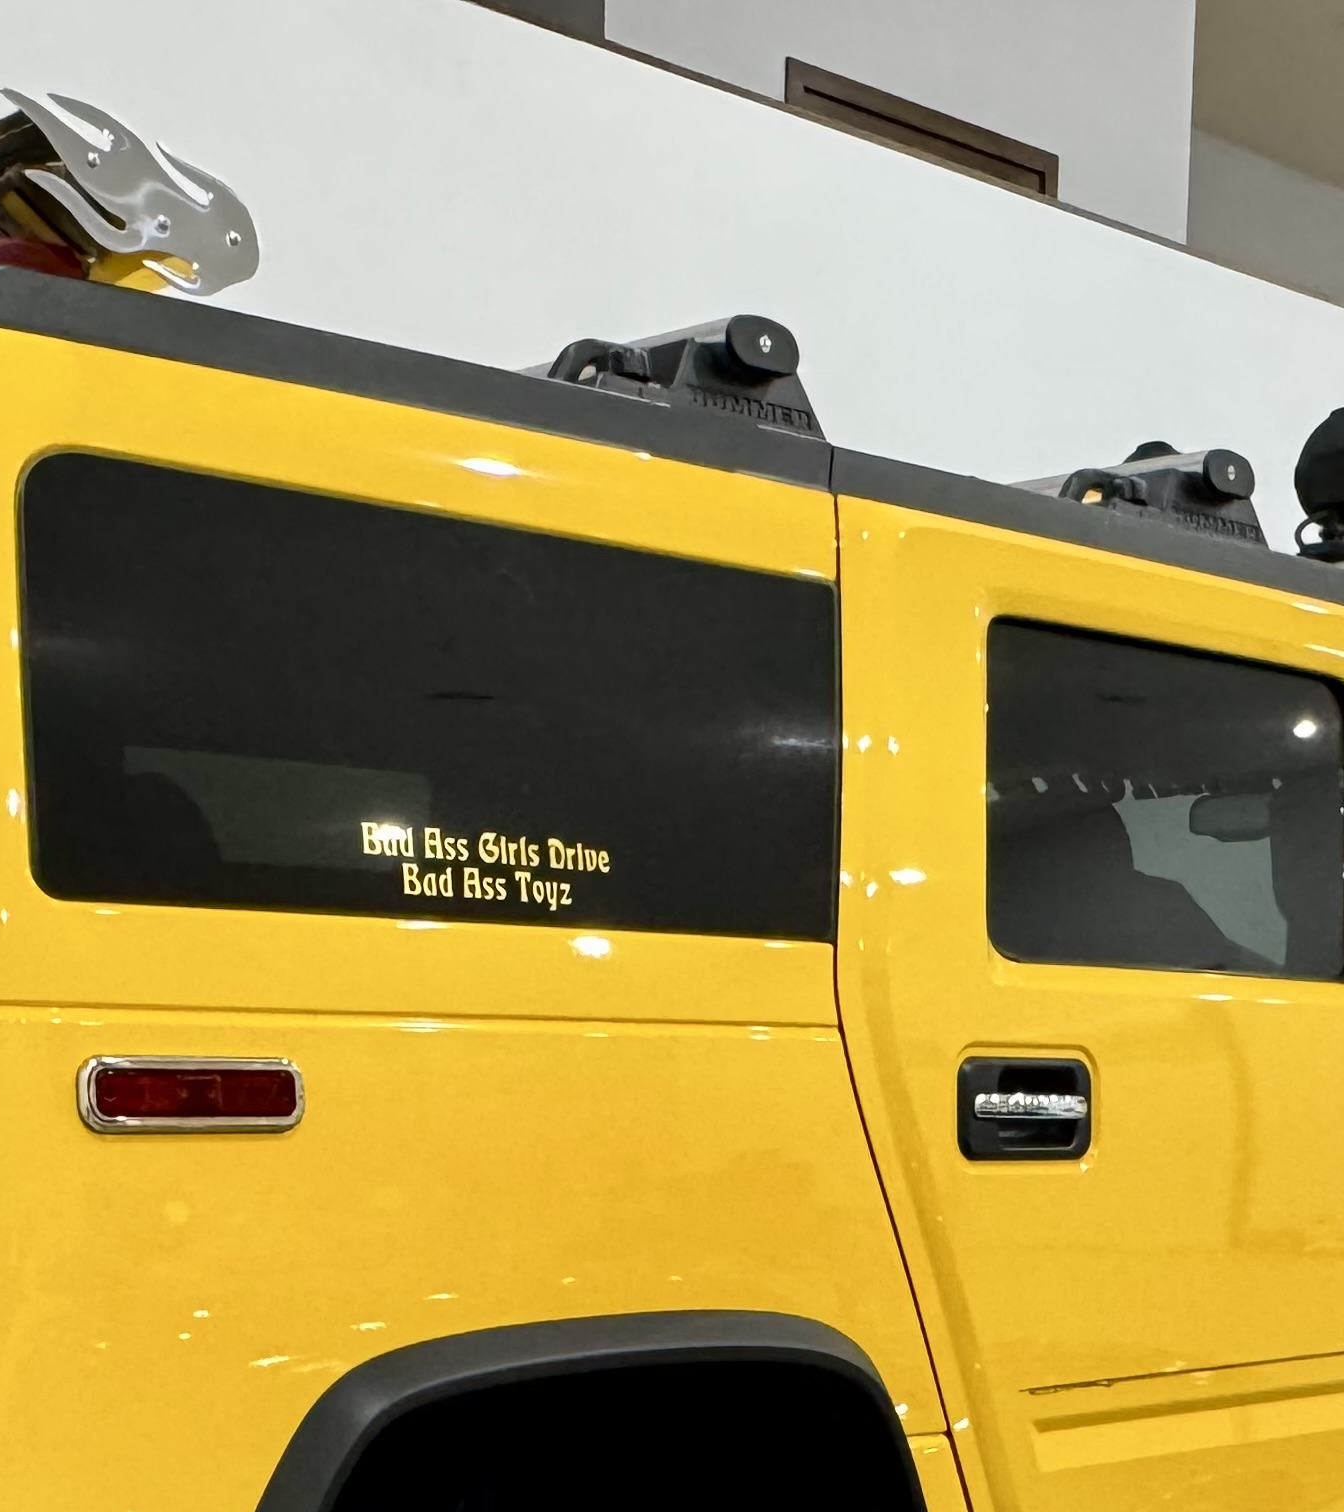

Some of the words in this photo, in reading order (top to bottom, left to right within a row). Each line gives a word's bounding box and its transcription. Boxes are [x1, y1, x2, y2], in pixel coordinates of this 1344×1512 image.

[424, 827, 469, 861] Ass
[478, 832, 540, 867] Girls
[547, 838, 611, 873] Drive
[402, 862, 454, 898] Bad
[463, 867, 507, 900] Ass
[514, 871, 573, 911] Toyz
